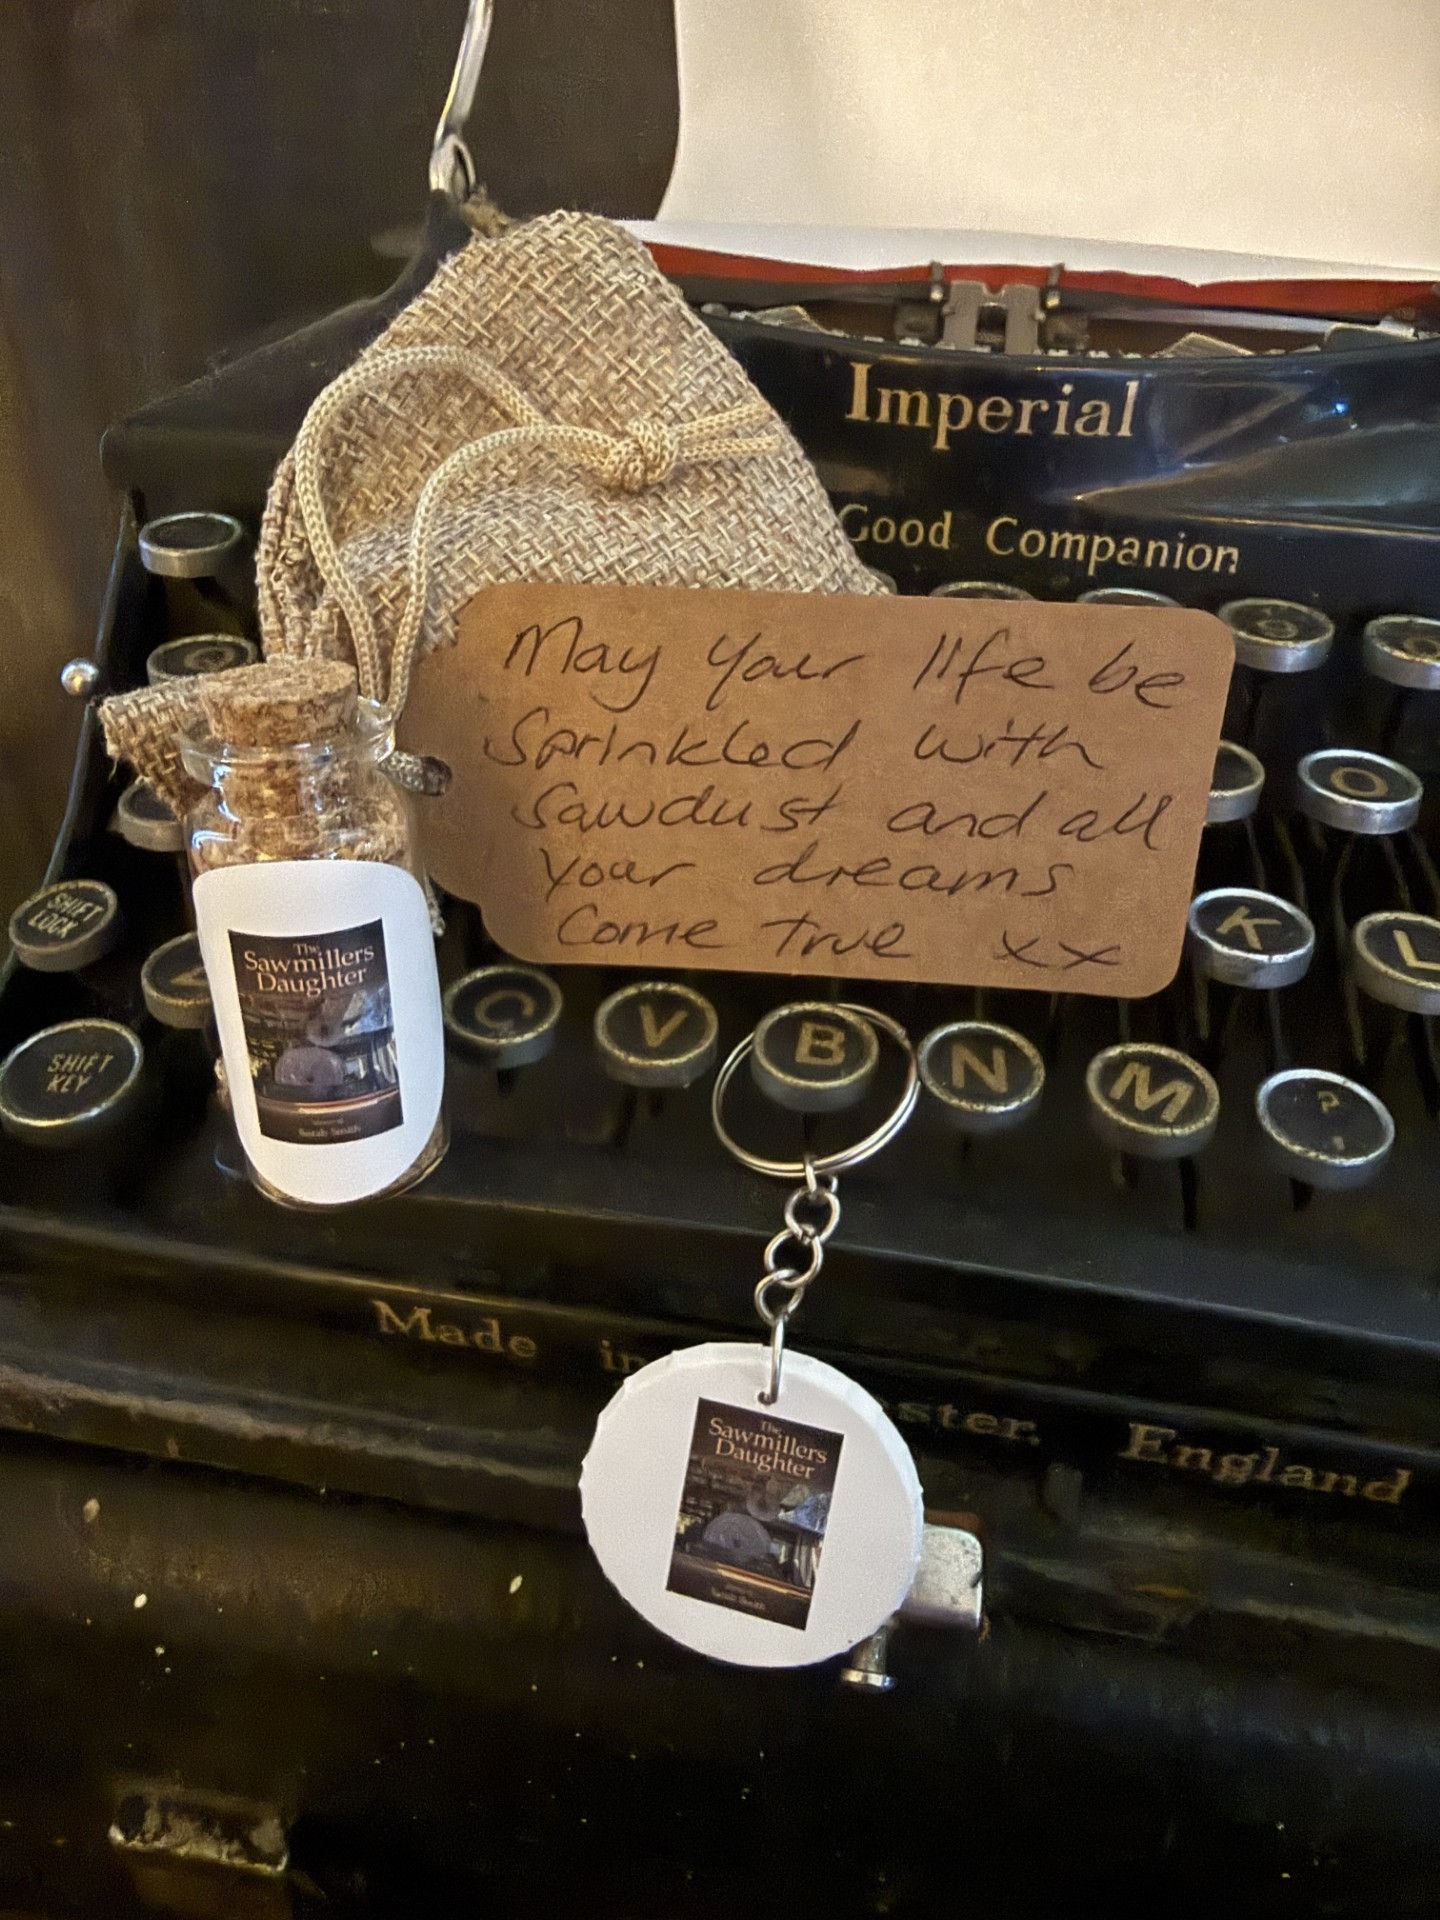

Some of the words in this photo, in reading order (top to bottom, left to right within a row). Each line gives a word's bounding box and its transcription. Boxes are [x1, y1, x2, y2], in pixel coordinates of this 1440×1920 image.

[845, 361, 1139, 449] Imperial
[838, 503, 952, 550] Good
[986, 516, 1240, 576] Companion
[504, 616, 662, 713] May
[913, 628, 1055, 704] life
[1088, 640, 1186, 708] be
[914, 718, 1104, 770] with
[887, 790, 1049, 838] and
[1058, 792, 1173, 850] all
[753, 840, 1074, 897] dreams
[27, 911, 79, 940] LOCK
[47, 892, 104, 923] SHIFT
[1216, 905, 1282, 950] K
[243, 945, 375, 975] Sawmillers
[1392, 929, 1440, 971] L
[256, 966, 368, 998] Daughter
[638, 1003, 688, 1049] V
[794, 1021, 846, 1066] B
[47, 1053, 114, 1073] SHIFT
[47, 1073, 92, 1094] KEY
[949, 1043, 1009, 1094] N
[1109, 1061, 1196, 1124] M
[371, 1299, 538, 1360] Made
[599, 1338, 650, 1374] in
[708, 1417, 829, 1464] Sawmillers
[714, 1438, 816, 1480] Daughter
[1118, 1422, 1413, 1504] England
